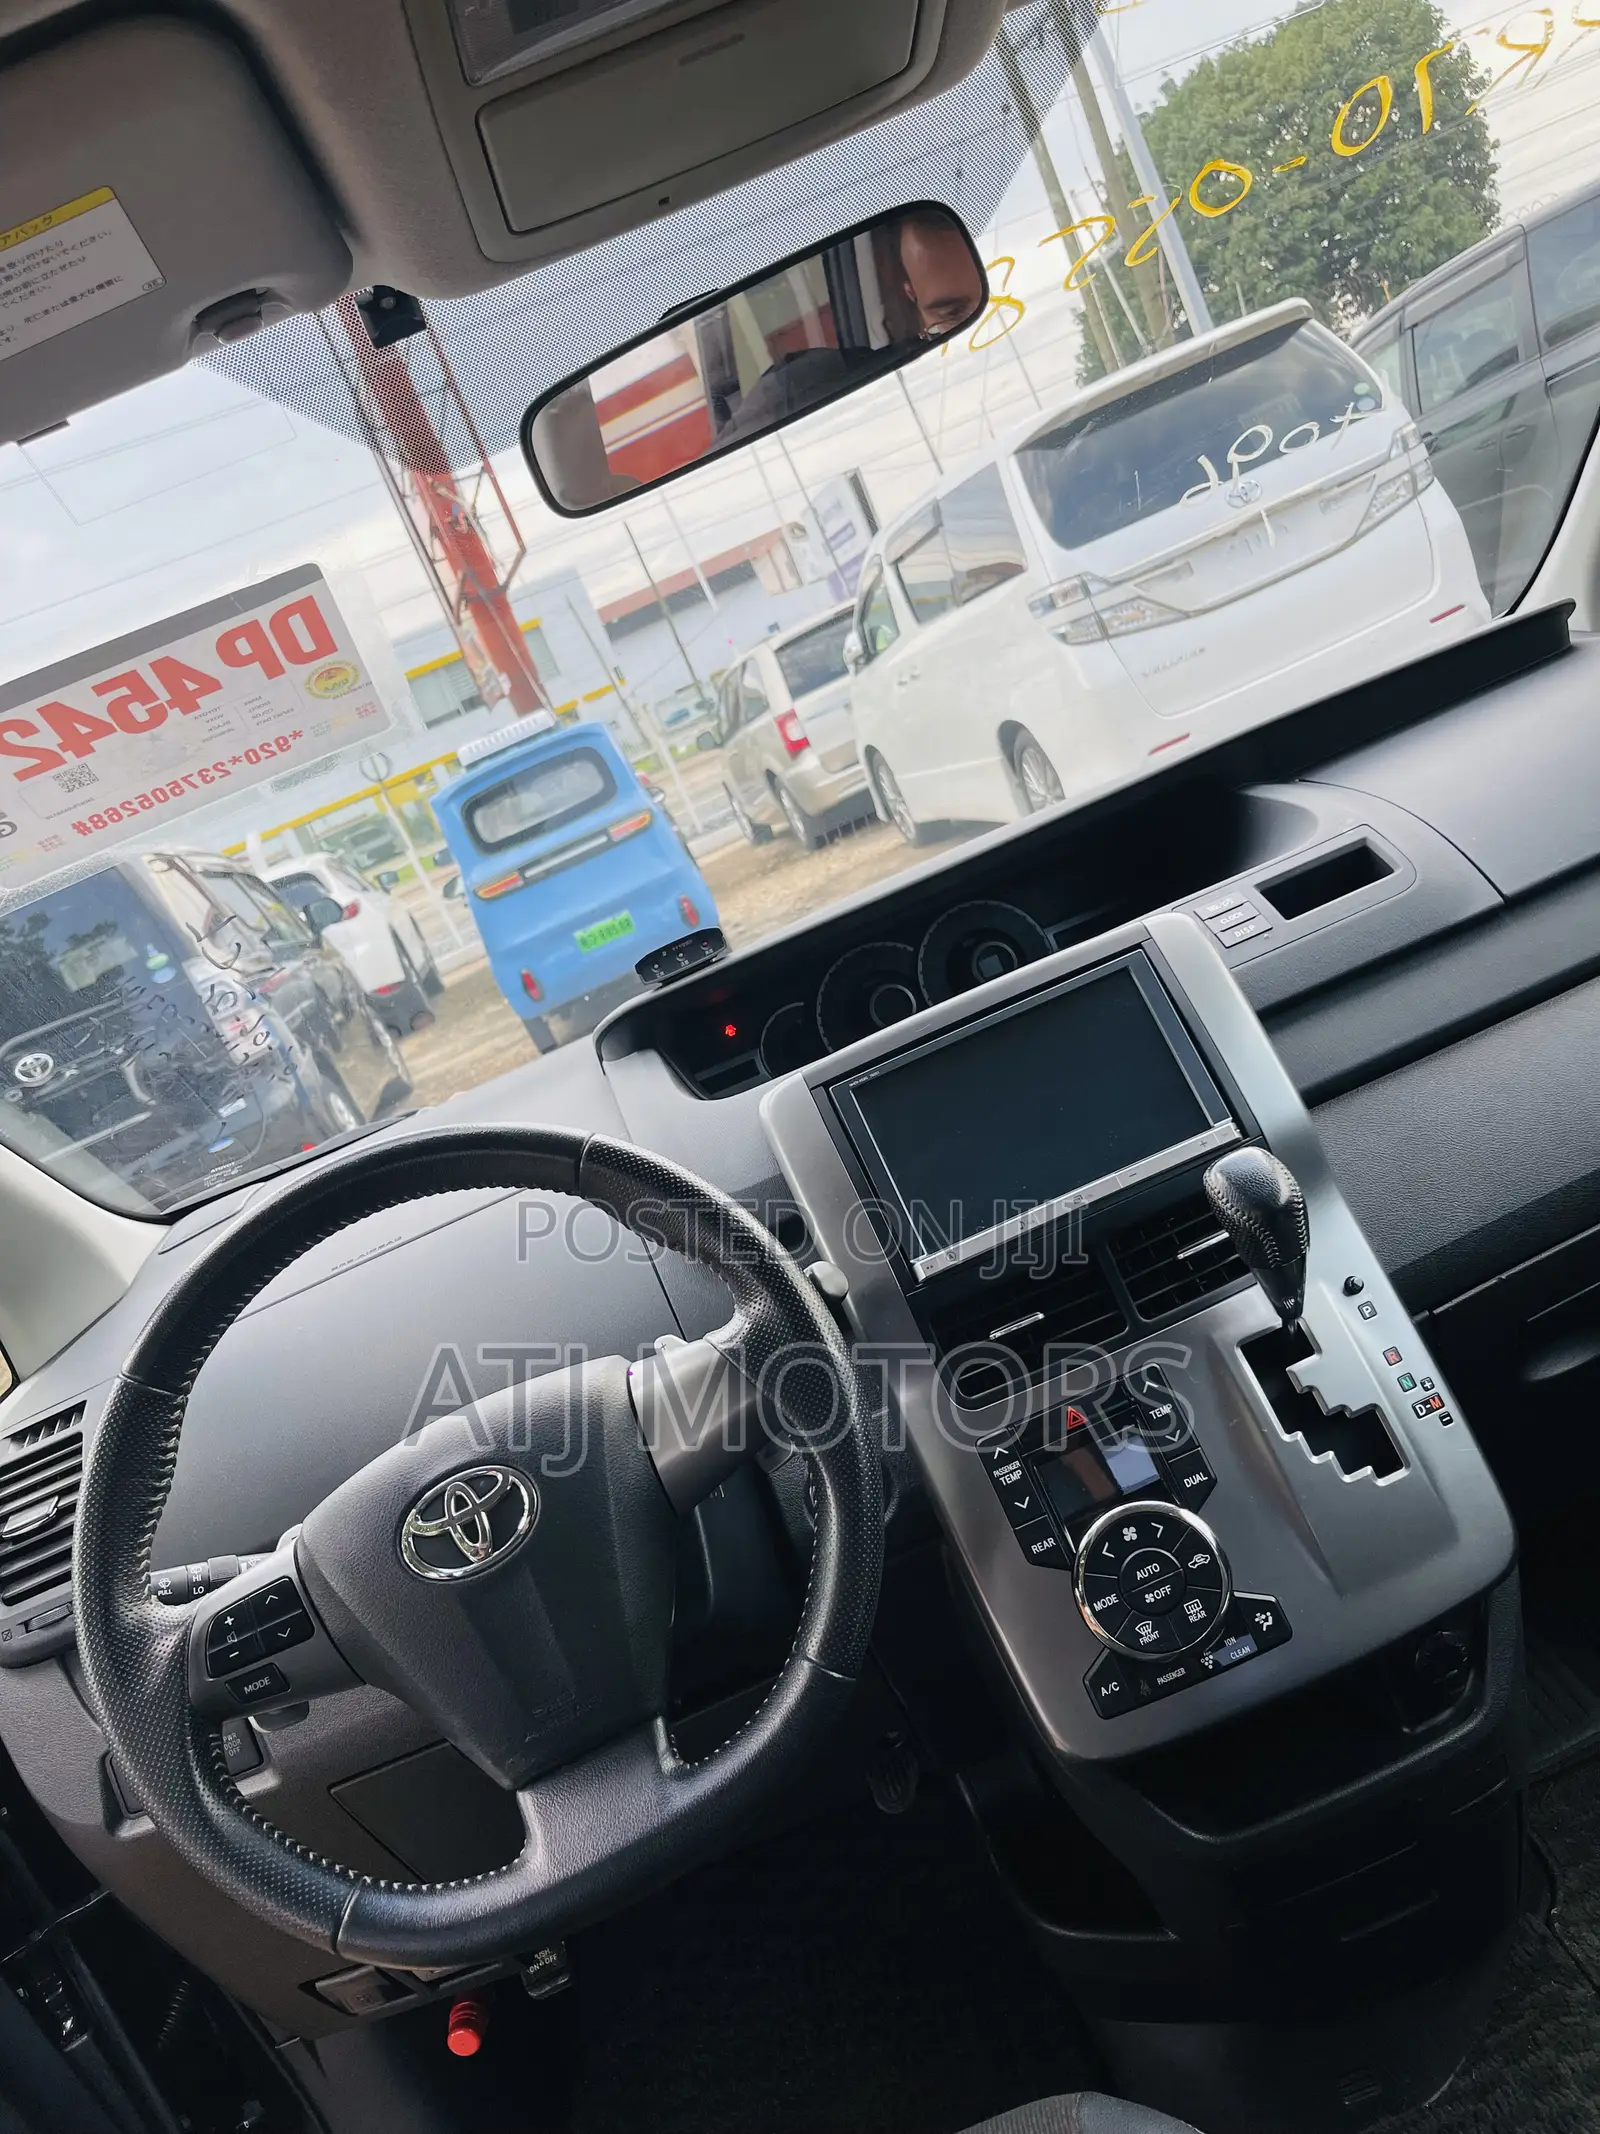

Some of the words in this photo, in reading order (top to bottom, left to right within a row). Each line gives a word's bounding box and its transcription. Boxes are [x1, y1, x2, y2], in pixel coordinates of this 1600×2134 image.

[1233, 924, 1256, 938] DISP
[1149, 1403, 1173, 1420] TEMP
[993, 1460, 1021, 1478] PASSENGER
[999, 1469, 1022, 1486] TEMP
[1183, 1472, 1208, 1488] DUAL
[1031, 1537, 1056, 1555] REAR
[192, 1573, 202, 1583] HI
[1136, 1562, 1160, 1580] AUTO
[157, 1588, 173, 1596] PULL
[193, 1586, 204, 1595] LO
[1154, 1584, 1172, 1600] OFF
[1093, 1593, 1120, 1612] MODE
[1188, 1609, 1207, 1624] REAR
[1139, 1630, 1160, 1646] FRONT
[1224, 1636, 1237, 1648] ION
[1229, 1645, 1251, 1660] CLEAN
[1156, 1667, 1187, 1685] PASSENGER
[243, 1676, 271, 1695] MODE
[1100, 1681, 1120, 1697] A/C
[223, 1740, 241, 1751] DOOR
[228, 1747, 240, 1757] OFF
